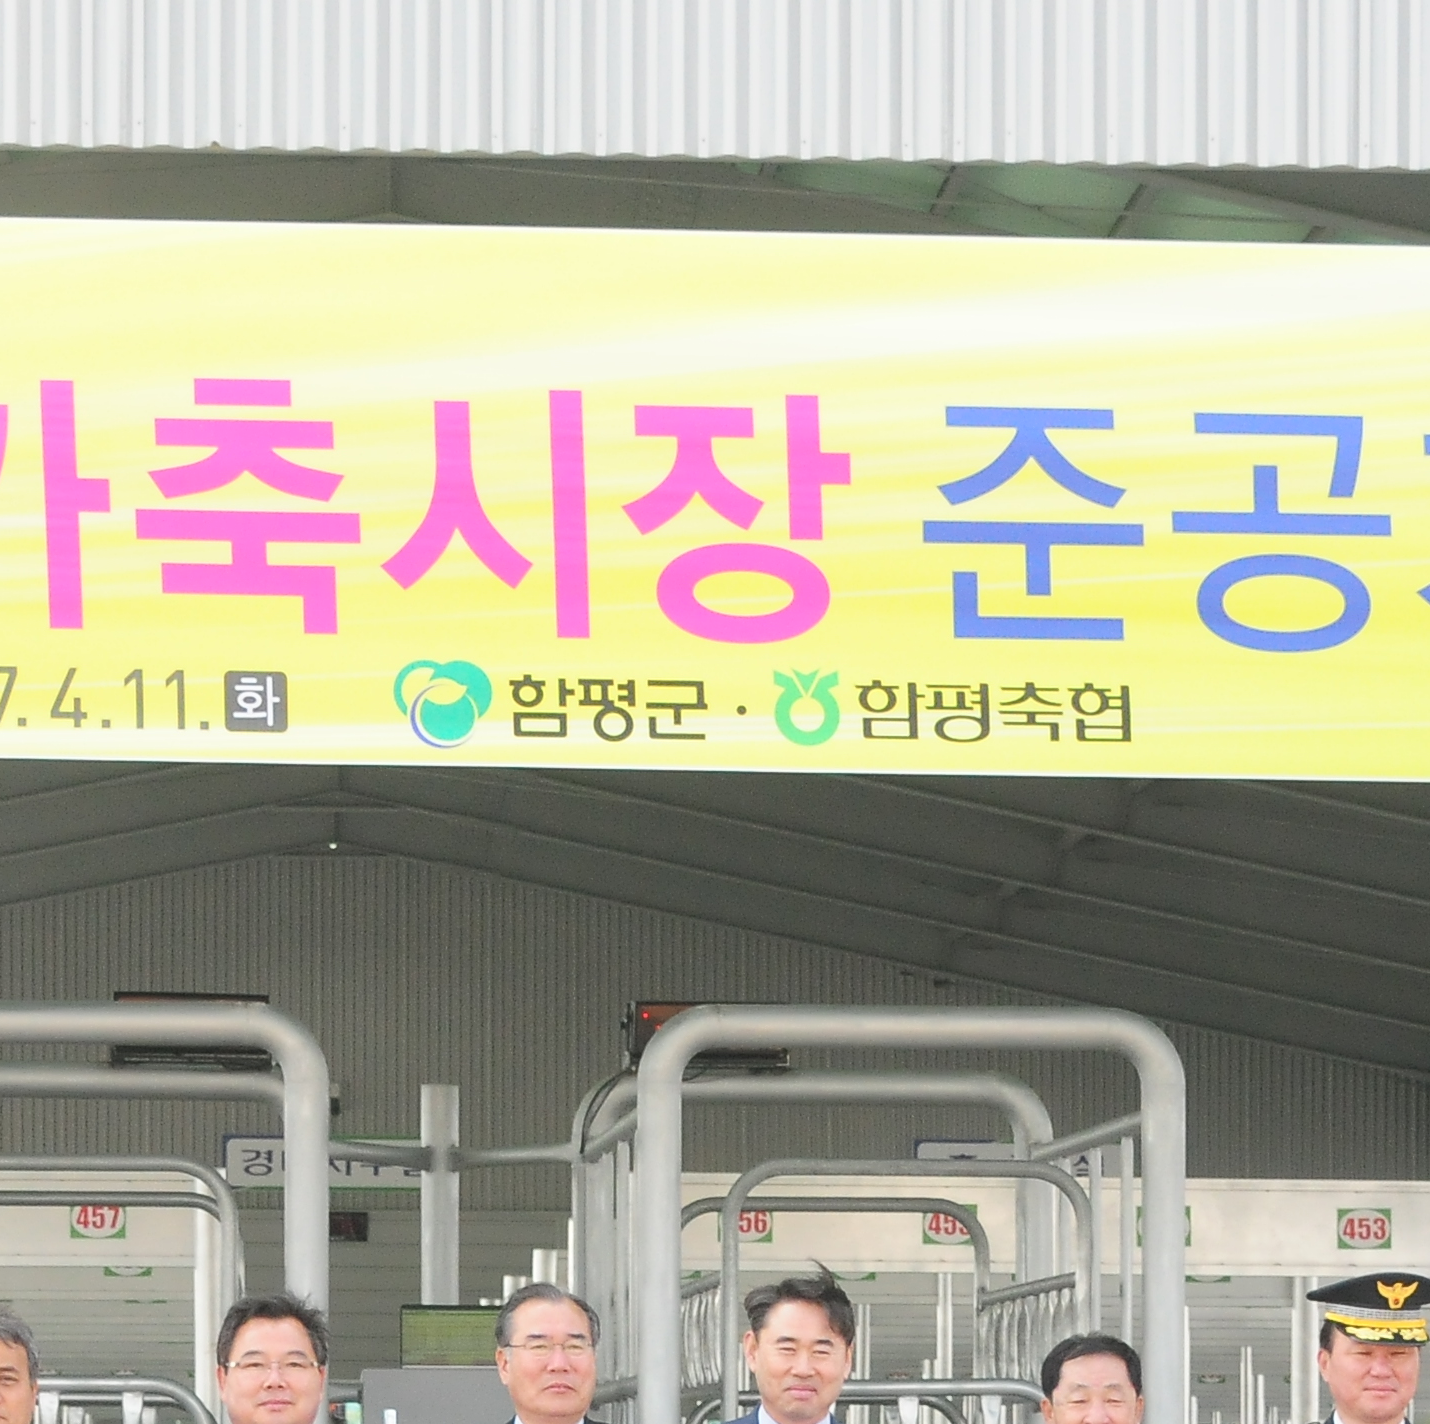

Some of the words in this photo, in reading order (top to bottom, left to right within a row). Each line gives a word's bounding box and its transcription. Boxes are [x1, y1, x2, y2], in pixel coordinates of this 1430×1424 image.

[231, 675, 282, 728] 화
[507, 672, 710, 743] 함평군
[853, 678, 1133, 744] 함평축협
[75, 1204, 122, 1230] 457
[737, 1210, 770, 1235] 56
[927, 1212, 969, 1236] 45
[1342, 1216, 1388, 1242] 453
